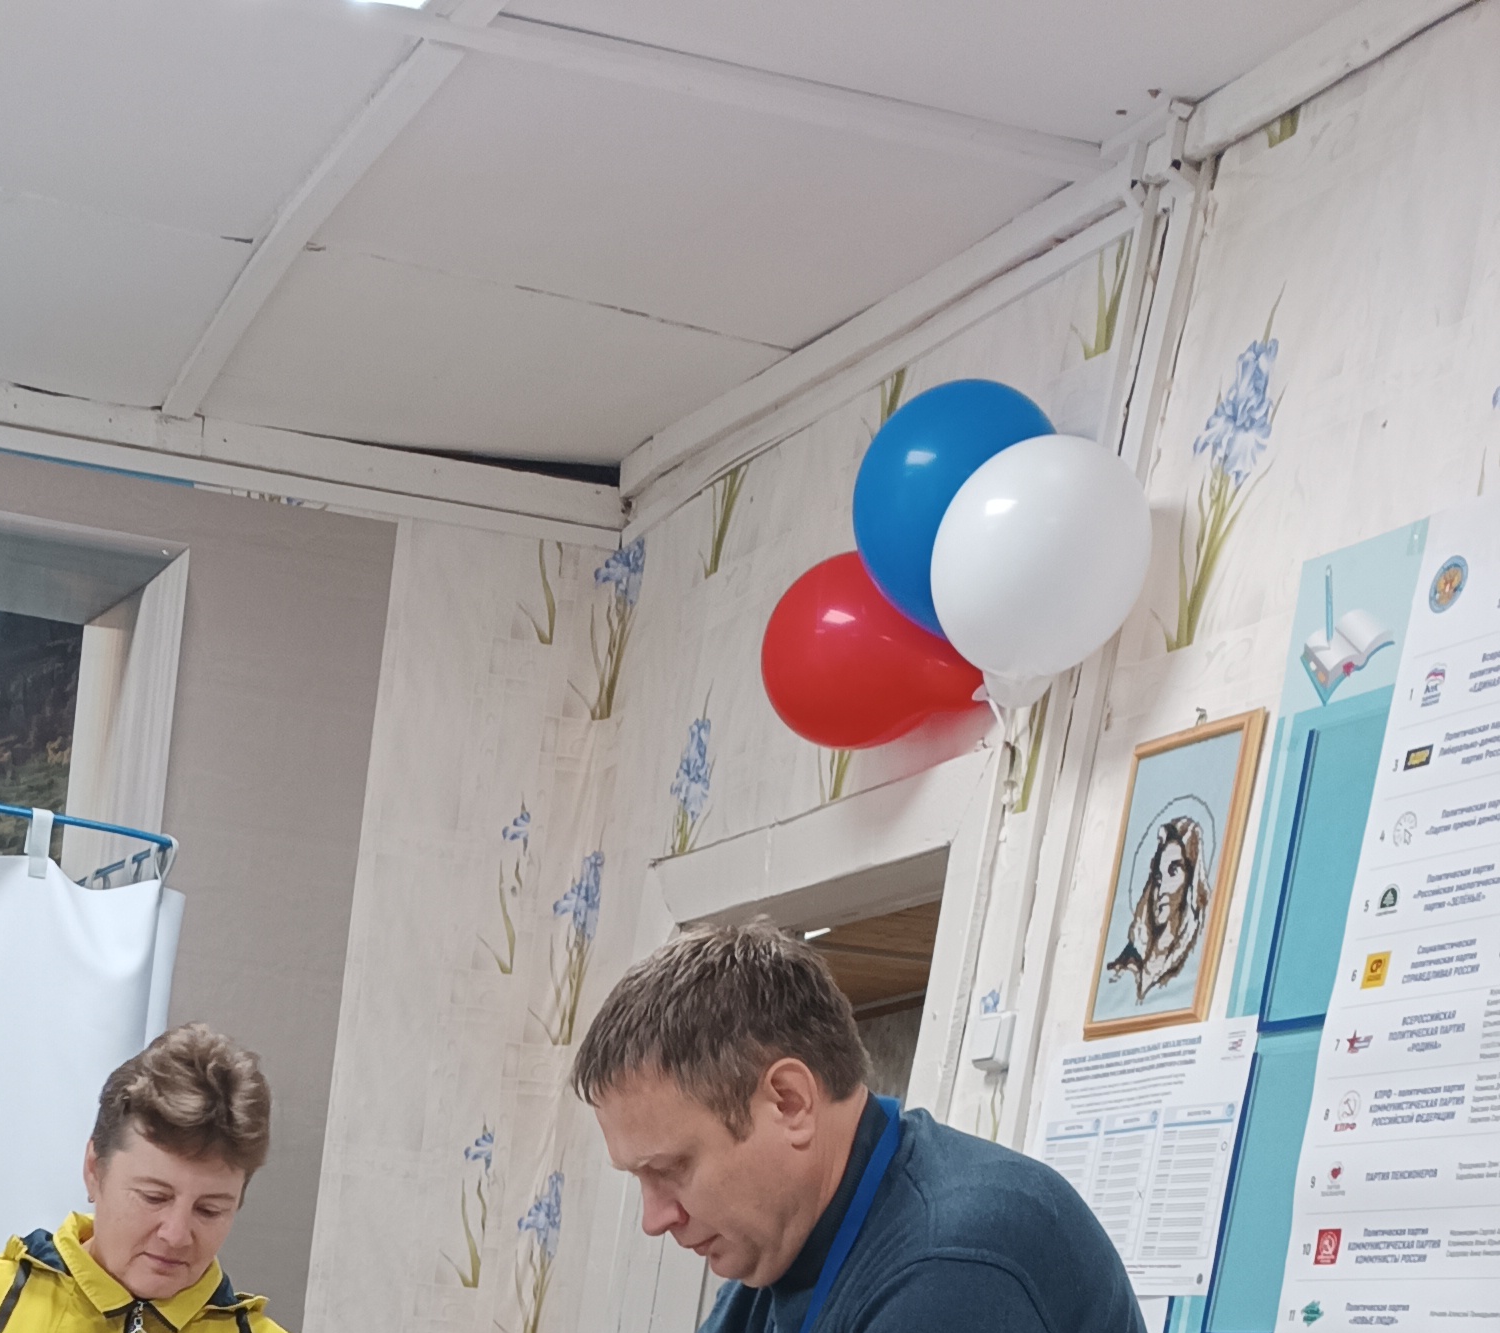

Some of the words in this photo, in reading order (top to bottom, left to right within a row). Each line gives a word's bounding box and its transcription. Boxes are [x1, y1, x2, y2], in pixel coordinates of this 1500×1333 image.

[1380, 830, 1386, 842] 4
[1364, 899, 1370, 913] 5
[1351, 969, 1358, 982] 6
[1334, 1038, 1340, 1051] 7
[1324, 1108, 1330, 1121] 8
[1310, 1176, 1316, 1189] 9
[1302, 1243, 1311, 1256] 10
[1289, 1310, 1296, 1321] 11
